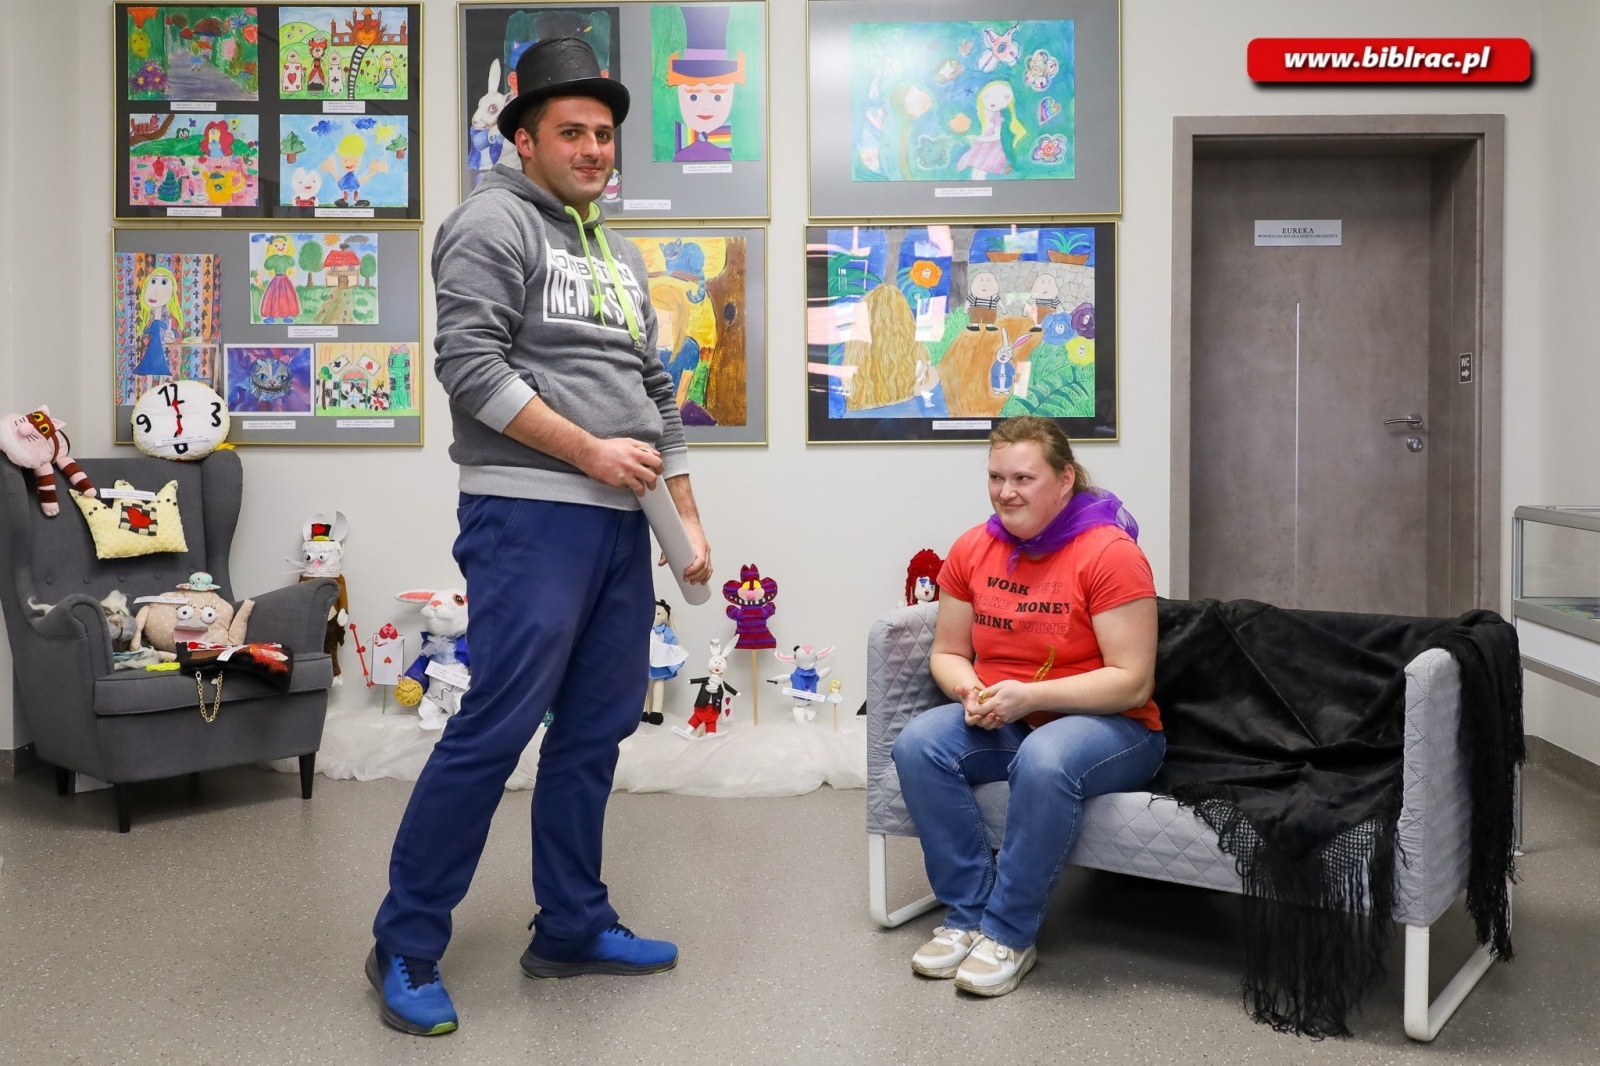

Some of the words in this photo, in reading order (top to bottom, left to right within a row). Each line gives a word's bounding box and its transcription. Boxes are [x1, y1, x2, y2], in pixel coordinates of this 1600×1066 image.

[1460, 357, 1470, 368] WC
[157, 383, 185, 407] 12
[136, 414, 152, 433] 9
[210, 402, 222, 427] 3
[987, 576, 1030, 596] WORK
[1015, 601, 1070, 614] MONEY
